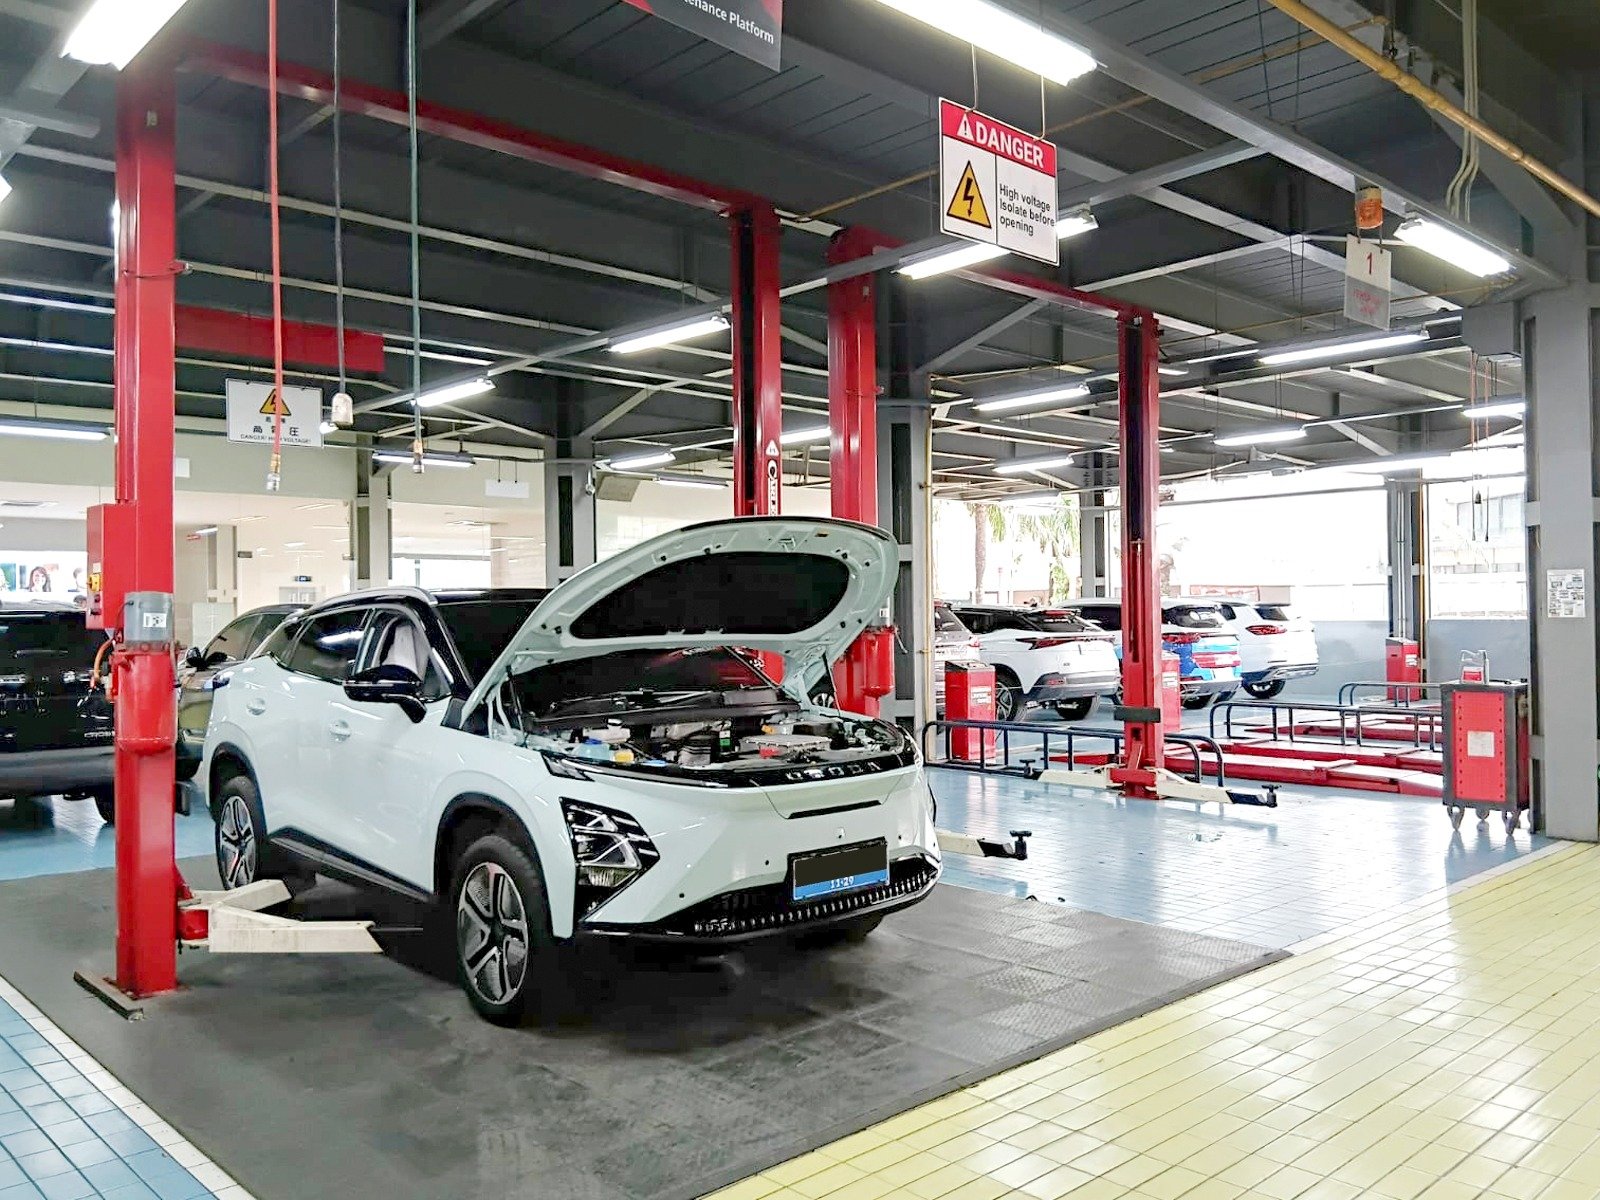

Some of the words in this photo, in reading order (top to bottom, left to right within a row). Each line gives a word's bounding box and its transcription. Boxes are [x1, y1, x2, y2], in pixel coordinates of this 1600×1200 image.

[729, 11, 774, 45] Platform
[975, 121, 1044, 169] DANGER
[999, 183, 1019, 201] High
[1022, 193, 1051, 212] voltage
[999, 198, 1028, 217] Isolate
[1029, 208, 1055, 227] before
[999, 215, 1034, 236] opening
[1366, 252, 1373, 275] 1
